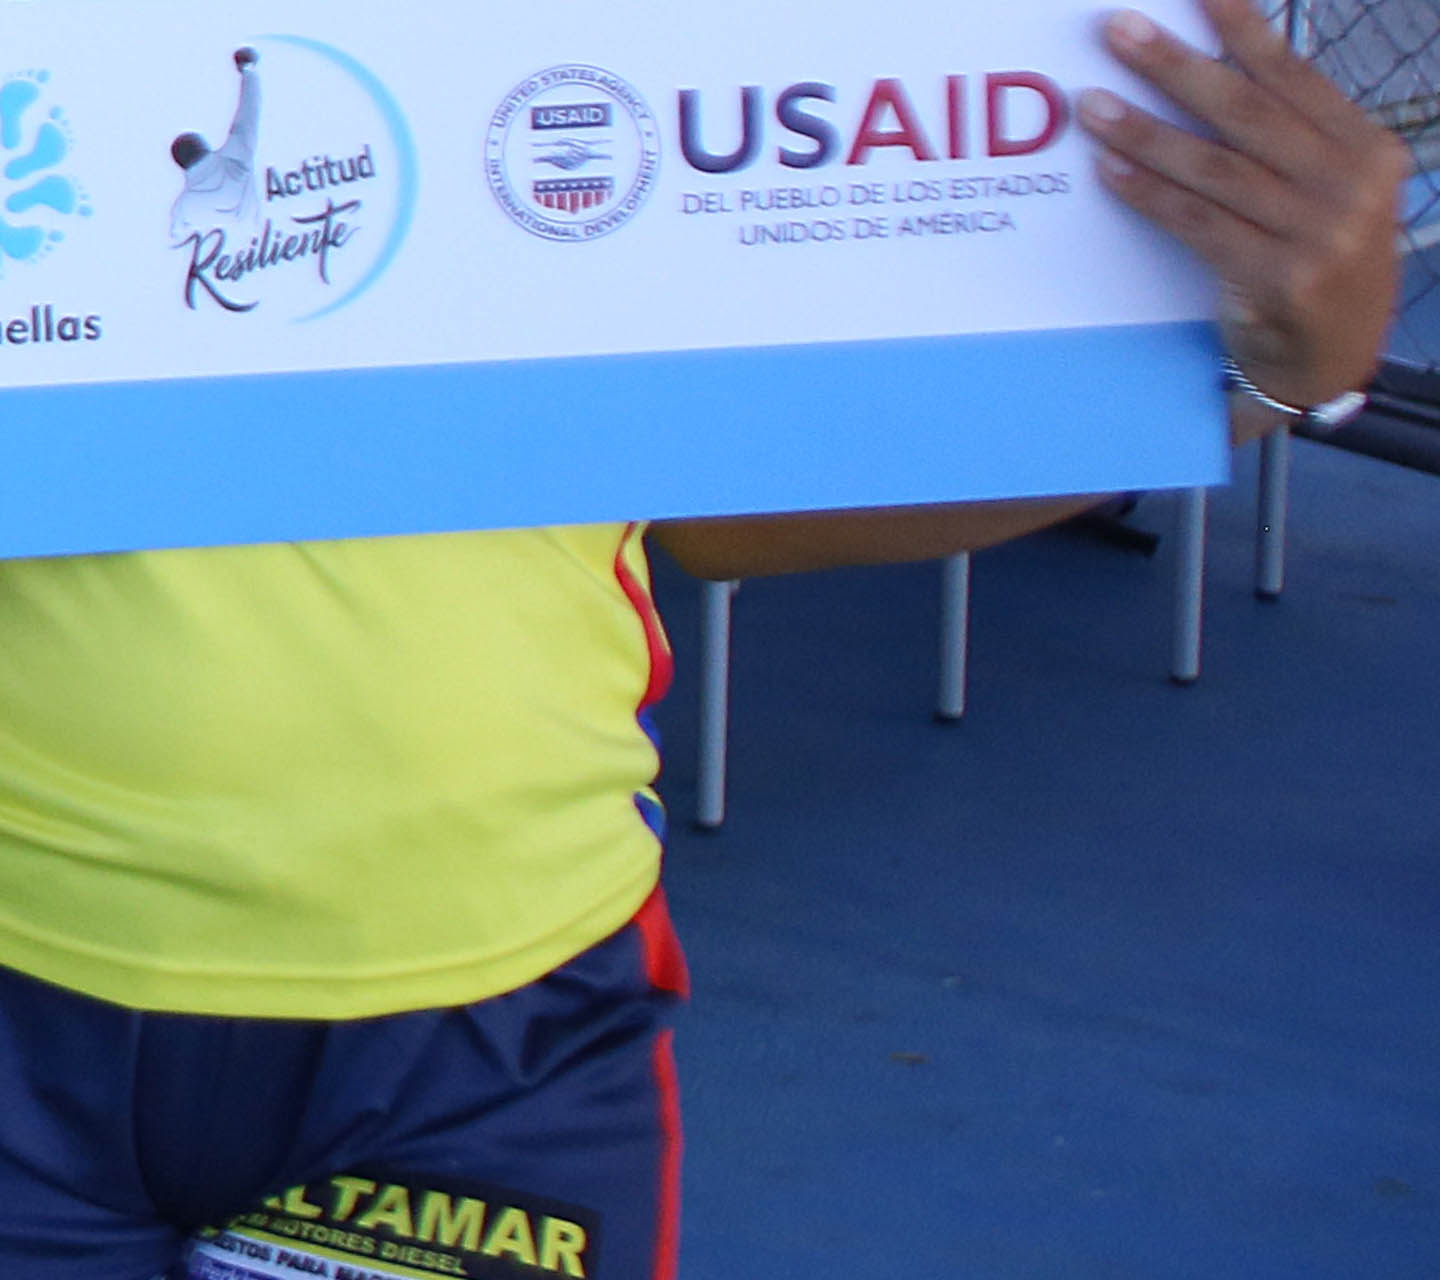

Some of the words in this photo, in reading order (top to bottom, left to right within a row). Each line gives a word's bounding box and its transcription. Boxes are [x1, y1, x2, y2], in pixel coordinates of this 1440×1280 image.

[537, 106, 604, 125] USAID
[677, 70, 1071, 174] USAID
[265, 143, 376, 203] Actitud
[681, 192, 731, 215] DEL
[740, 186, 841, 212] PUEBLO
[848, 183, 886, 206] DE
[892, 180, 943, 204] LOS
[949, 172, 1071, 200] ESTADOS
[738, 219, 847, 246] UNIDOS
[853, 217, 888, 240] DE
[897, 210, 1017, 238] AMÉRICA
[171, 198, 361, 313] Resiliente
